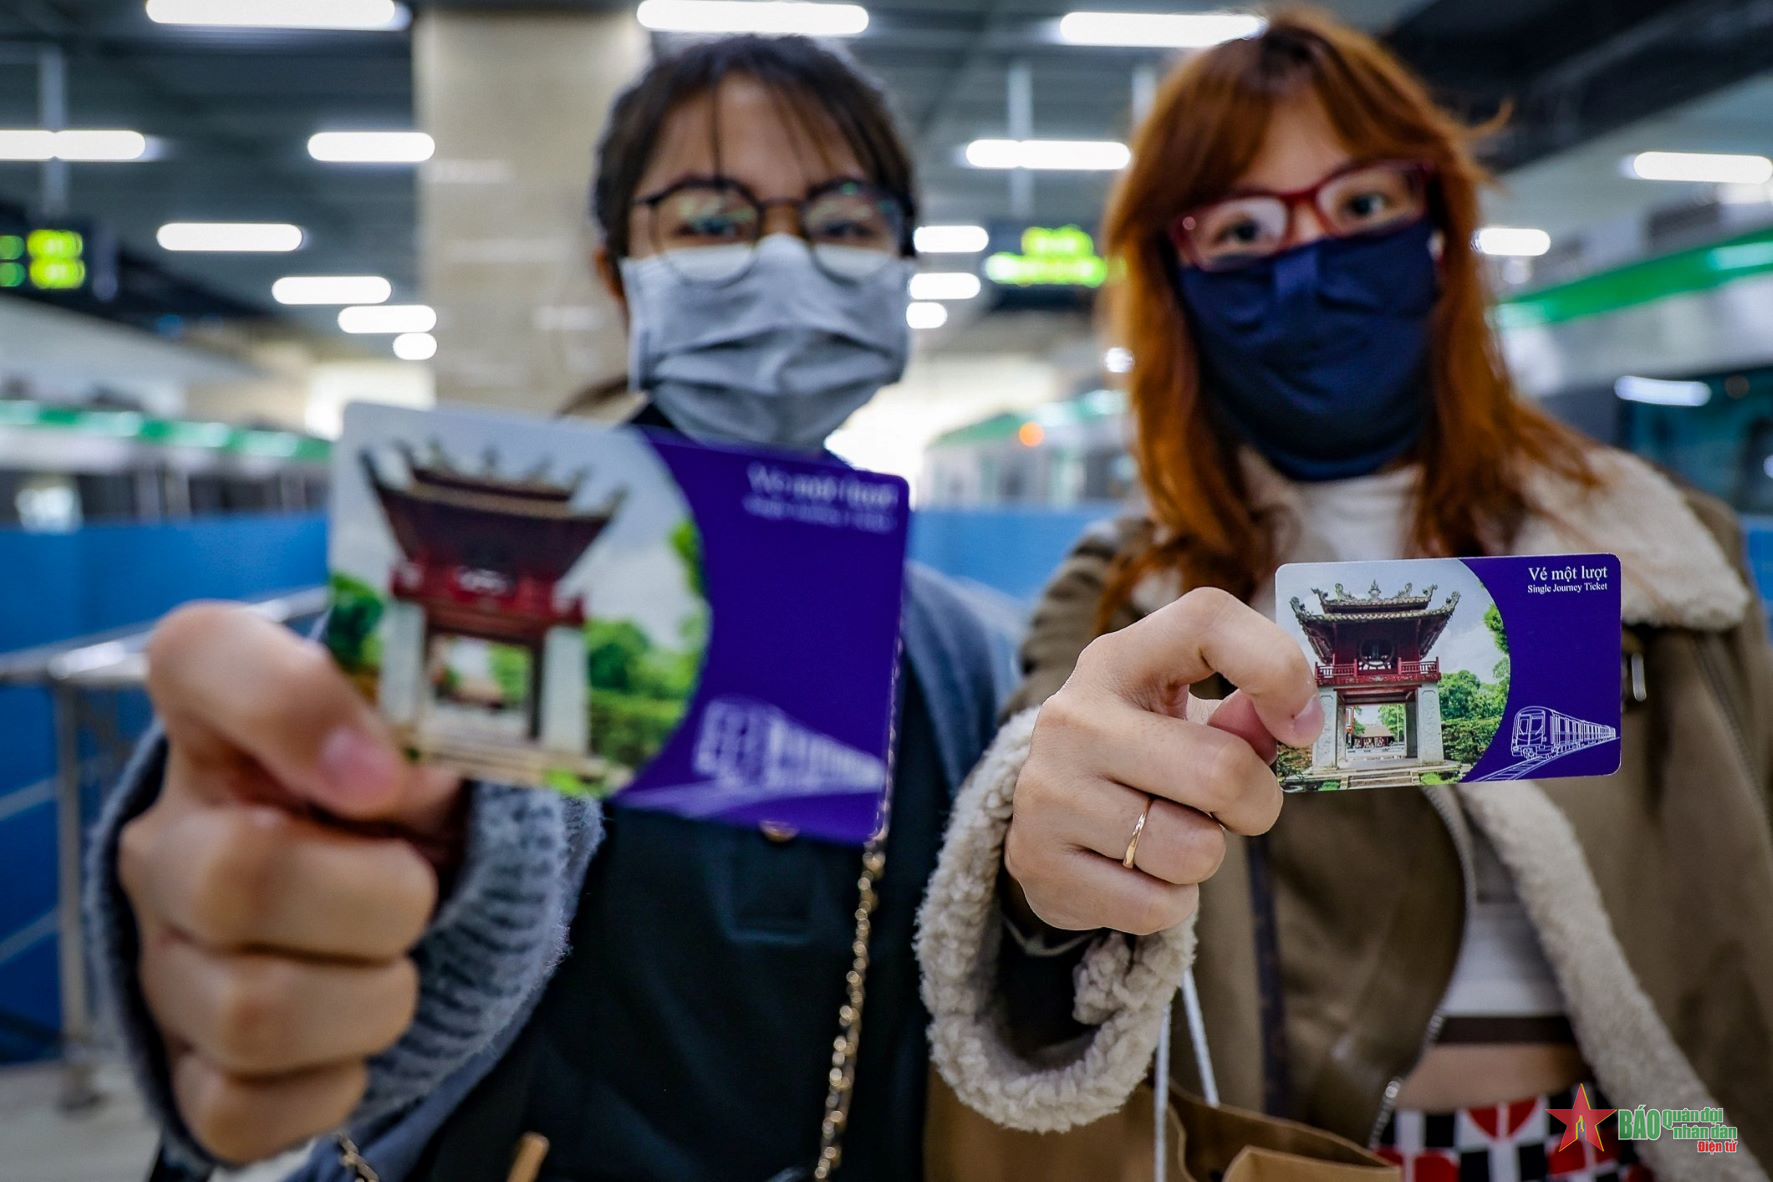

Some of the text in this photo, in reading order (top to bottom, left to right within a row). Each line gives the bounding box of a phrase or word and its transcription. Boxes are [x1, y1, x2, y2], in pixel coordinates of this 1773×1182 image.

[1528, 565, 1608, 582] Vé một lượt
[1527, 582, 1608, 595] Single Journey Ticket
